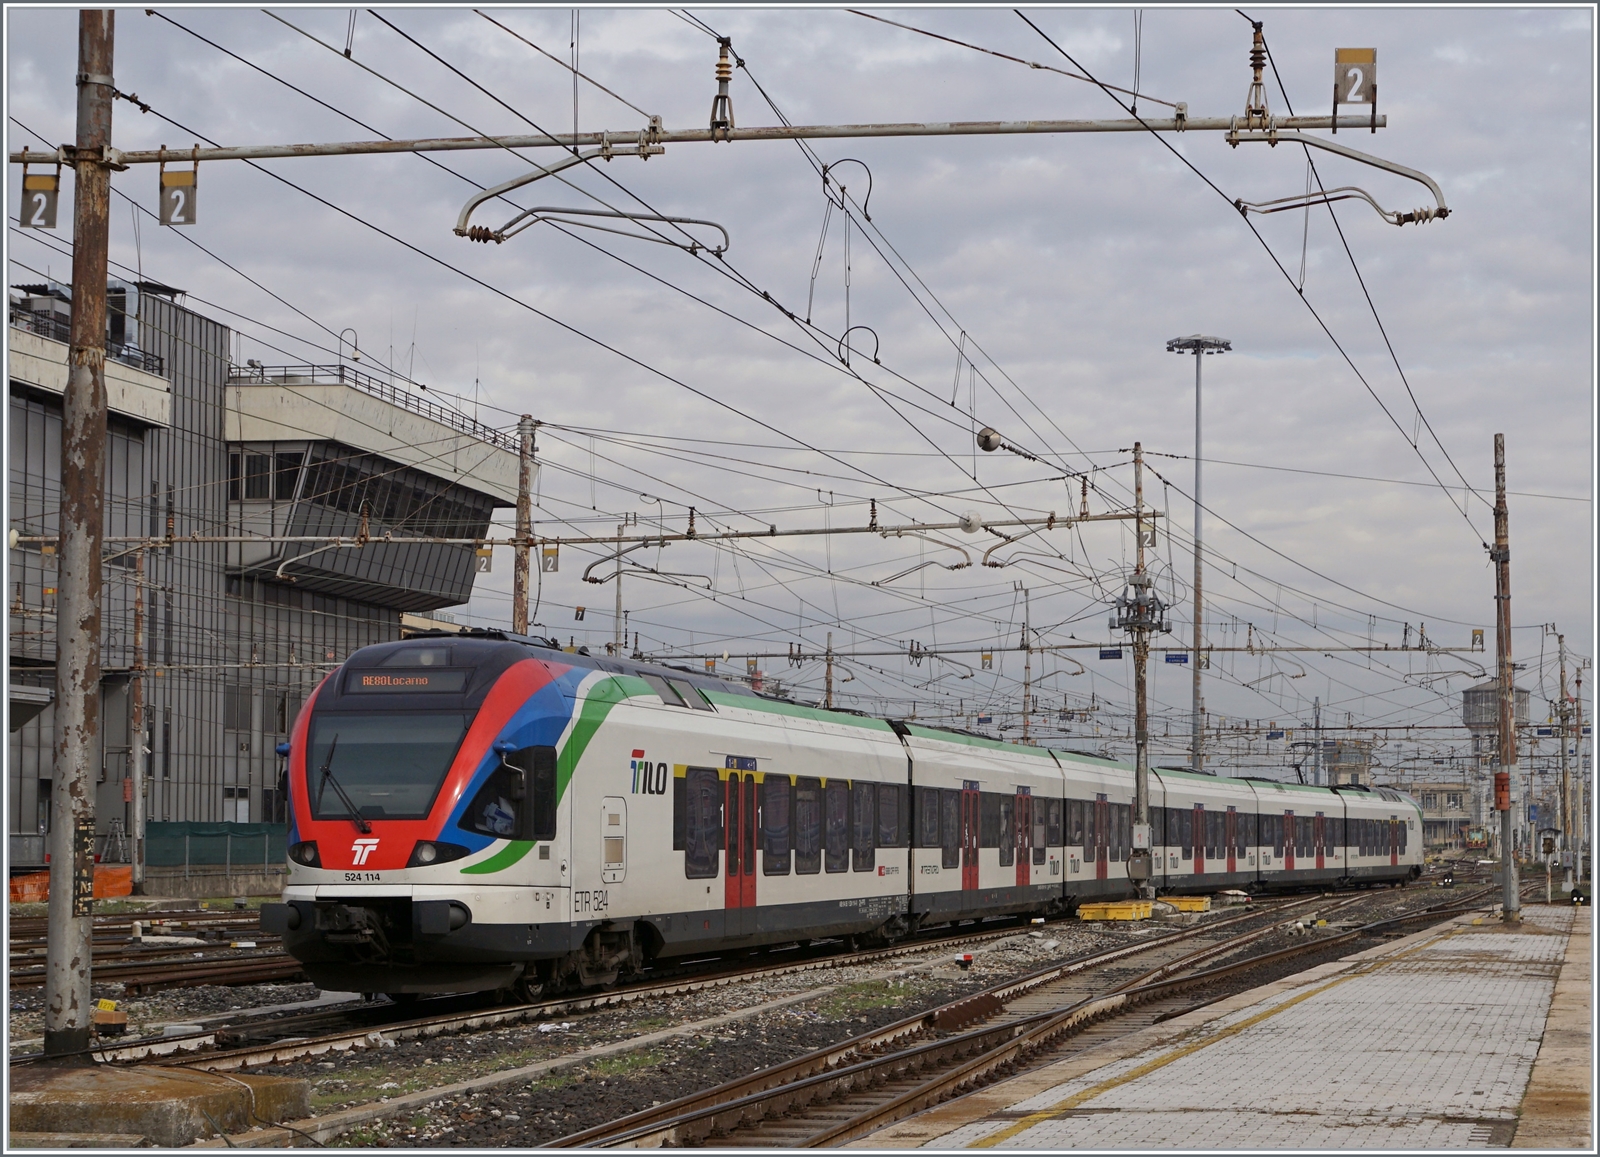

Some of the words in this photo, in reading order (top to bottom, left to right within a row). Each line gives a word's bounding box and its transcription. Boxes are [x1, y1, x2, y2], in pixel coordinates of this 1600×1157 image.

[1347, 67, 1364, 102] 2
[30, 192, 48, 226] 2
[170, 189, 185, 223] 2
[1142, 531, 1152, 547] 2
[479, 556, 487, 572] 2
[546, 556, 554, 572] 2
[577, 611, 582, 620] 7
[1475, 634, 1481, 645] 2
[984, 660, 990, 669] 2
[1201, 659, 1207, 669] 2
[1137, 833, 1142, 843] 1
[345, 873, 362, 881] 524
[365, 873, 380, 881] 114
[574, 890, 591, 913] ETR
[593, 889, 609, 912] 524
